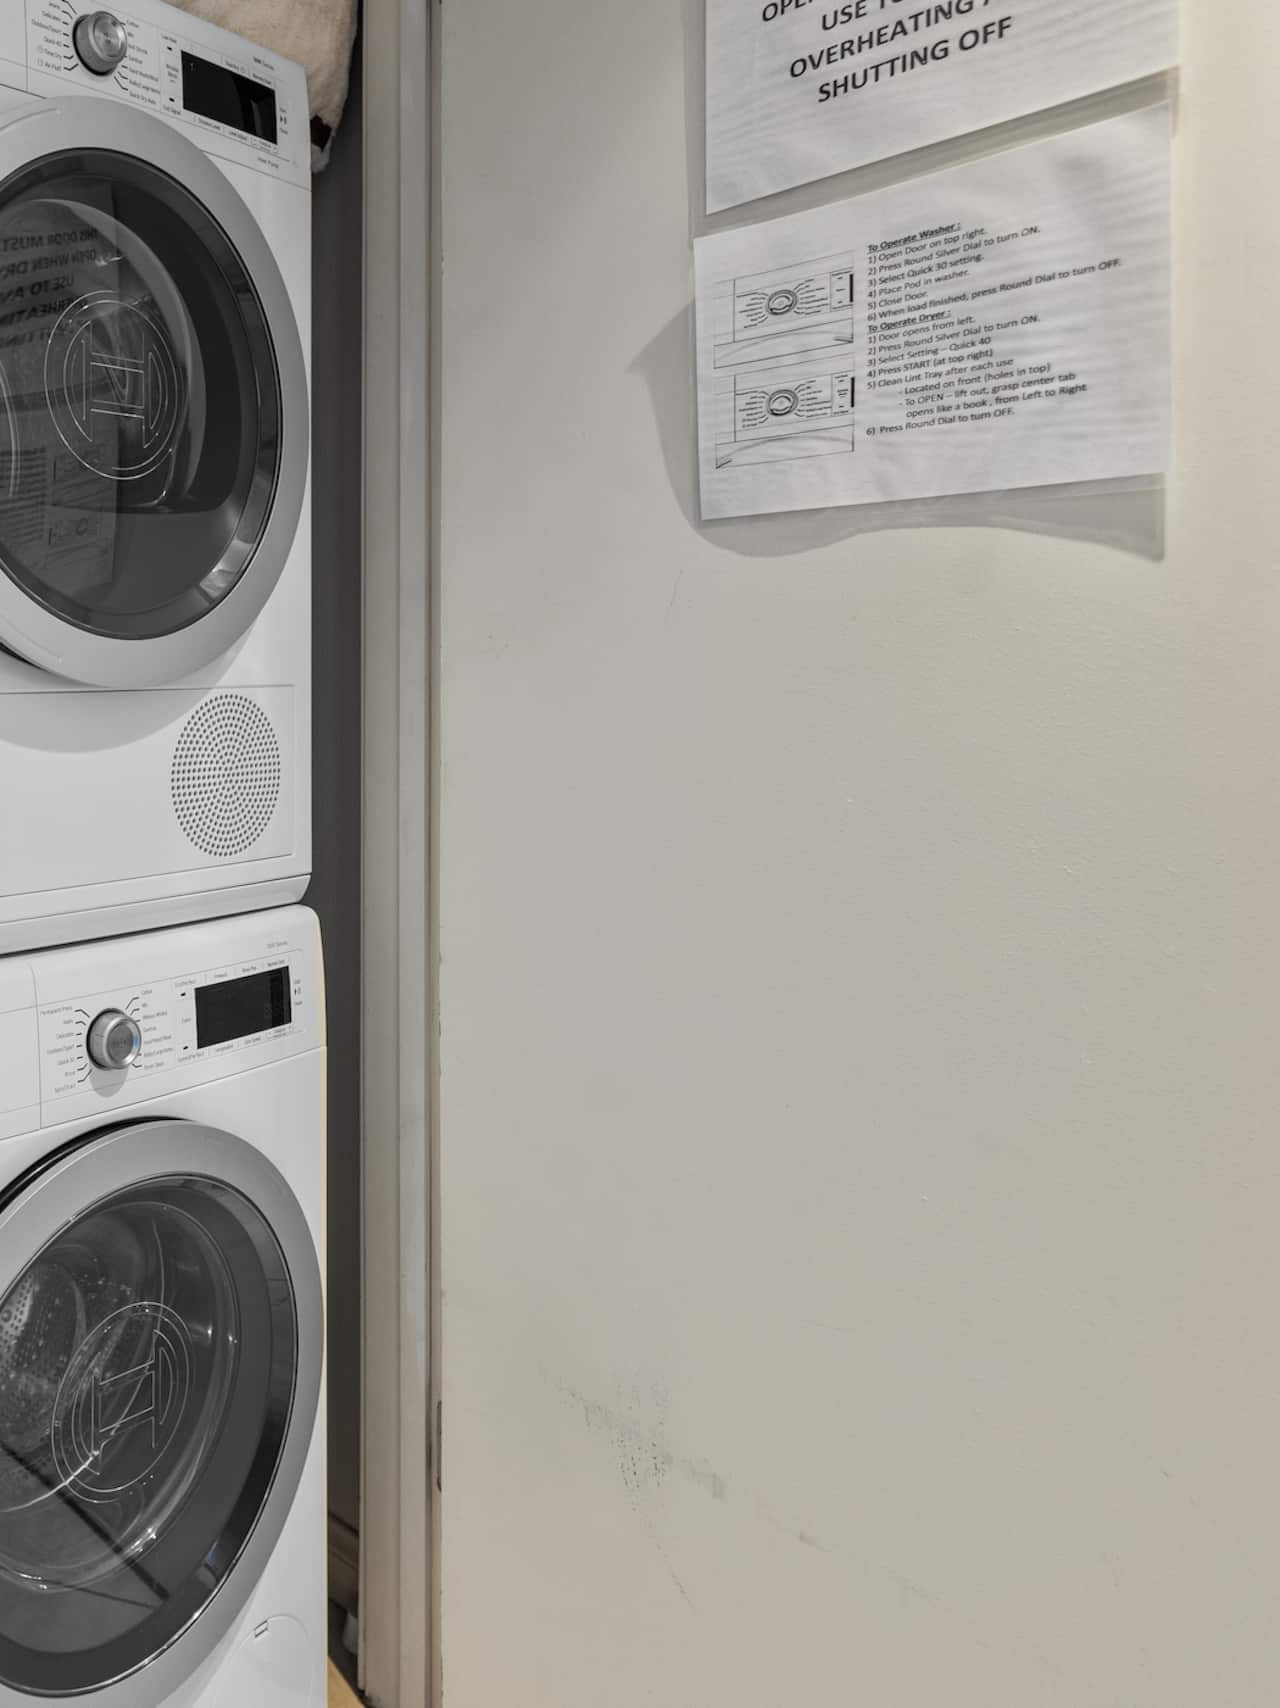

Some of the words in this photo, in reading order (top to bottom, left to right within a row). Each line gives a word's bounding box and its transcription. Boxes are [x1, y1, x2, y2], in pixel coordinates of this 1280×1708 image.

[762, 0, 813, 22] OP
[821, 0, 868, 31] USE
[790, 0, 975, 78] OVERHEATING
[817, 40, 949, 103] SHUTTING
[959, 17, 1014, 51] OFF
[878, 249, 903, 262] Open
[905, 243, 926, 254] Door
[944, 236, 960, 245] top
[879, 262, 902, 273] Press
[904, 254, 933, 265] Round
[936, 245, 960, 258] Silver
[963, 239, 982, 250] Dial
[984, 238, 994, 246] to
[996, 232, 1018, 243] turn
[880, 234, 916, 249] Operate
[879, 272, 905, 284] Select
[907, 264, 933, 278] Quick
[936, 259, 947, 268] 30
[879, 284, 902, 296] Place
[904, 280, 921, 290] Pod
[924, 277, 932, 285] in
[879, 307, 905, 318] When
[908, 301, 927, 312] load
[971, 286, 997, 300] press
[1000, 278, 1032, 292] Round
[1035, 272, 1056, 284] Dial
[1058, 269, 1070, 279] to
[1072, 265, 1095, 276] turn
[879, 296, 902, 307] Close
[878, 342, 901, 353] Press
[904, 334, 933, 346] Round
[936, 329, 960, 342] Silver
[963, 325, 982, 336] Dial
[984, 323, 994, 332] to
[996, 319, 1018, 329] turn
[879, 332, 899, 342] Door
[903, 325, 930, 337] opens
[932, 319, 954, 330] from
[880, 316, 917, 330] Operate
[878, 353, 904, 364] Select
[907, 346, 939, 359] Setting
[949, 341, 976, 352] Quick
[978, 336, 992, 345] 40
[878, 364, 901, 376] Press
[904, 359, 930, 371] START
[933, 356, 946, 367] (at
[948, 353, 965, 363] top
[878, 376, 902, 388] Clean
[905, 372, 922, 382] Lint
[924, 369, 943, 381] Tray
[945, 365, 968, 376] after
[970, 361, 994, 372] each
[996, 358, 1014, 367] use
[904, 381, 940, 395] Located
[943, 379, 956, 388] on
[958, 374, 981, 385] front
[984, 369, 1014, 384] (holes
[1017, 367, 1026, 376] in
[1029, 363, 1051, 375] top)
[905, 398, 915, 406] To
[918, 394, 944, 404] OPEN
[954, 388, 968, 398] lift
[992, 382, 1020, 395] grasp
[1022, 376, 1055, 388] center
[1058, 373, 1076, 381] tab
[906, 407, 934, 418] opens
[936, 402, 953, 412] like
[995, 394, 1019, 405] from
[1022, 390, 1043, 400] Left
[1045, 389, 1055, 397] to
[880, 424, 903, 434] Press
[905, 419, 935, 430] Round
[938, 415, 955, 425] Dial
[958, 413, 968, 422] to
[971, 410, 991, 420] turn
